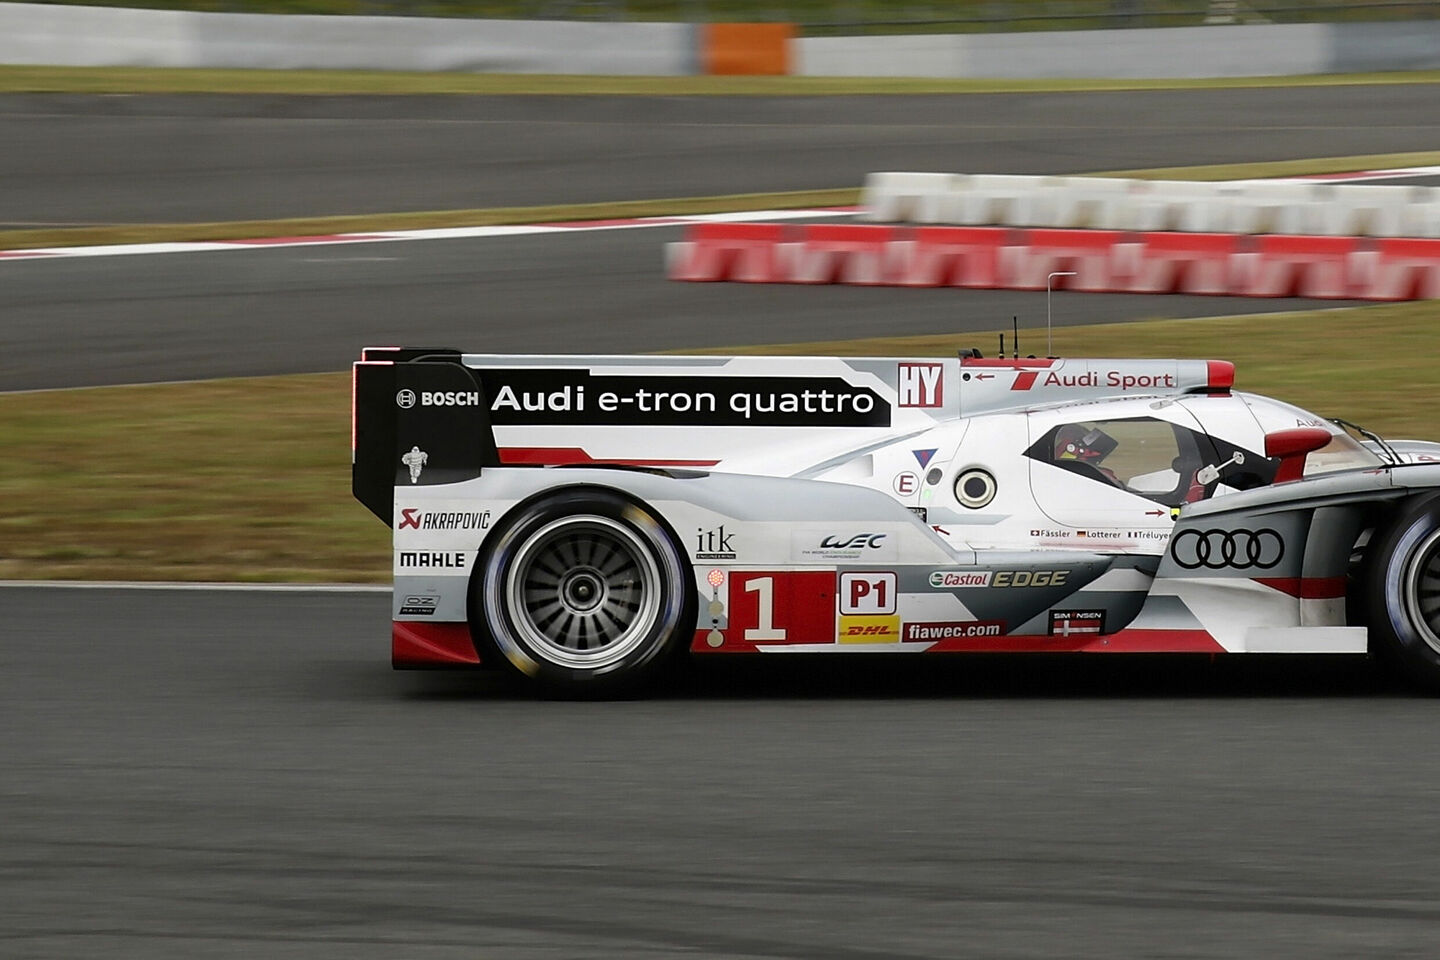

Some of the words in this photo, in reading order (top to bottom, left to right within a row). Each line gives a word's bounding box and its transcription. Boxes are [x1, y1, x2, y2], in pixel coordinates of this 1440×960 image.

[899, 366, 942, 406] HY
[1044, 372, 1098, 387] Audi
[1106, 372, 1173, 389] Sport
[421, 392, 479, 406] BOSCH
[491, 386, 584, 410] Audi
[598, 389, 715, 412] e-tron
[729, 390, 874, 418] quattro
[899, 475, 914, 492] E
[423, 510, 490, 529] AKRAPOVIČ
[697, 525, 736, 552] itk
[820, 534, 887, 548] WEC
[400, 553, 465, 567] MAHLE
[945, 574, 987, 586] Castrol
[993, 571, 1070, 586] EDGE
[851, 580, 886, 608] P1
[745, 577, 787, 640] 1
[848, 626, 891, 635] DHL
[909, 624, 1000, 640] fiawec.com
